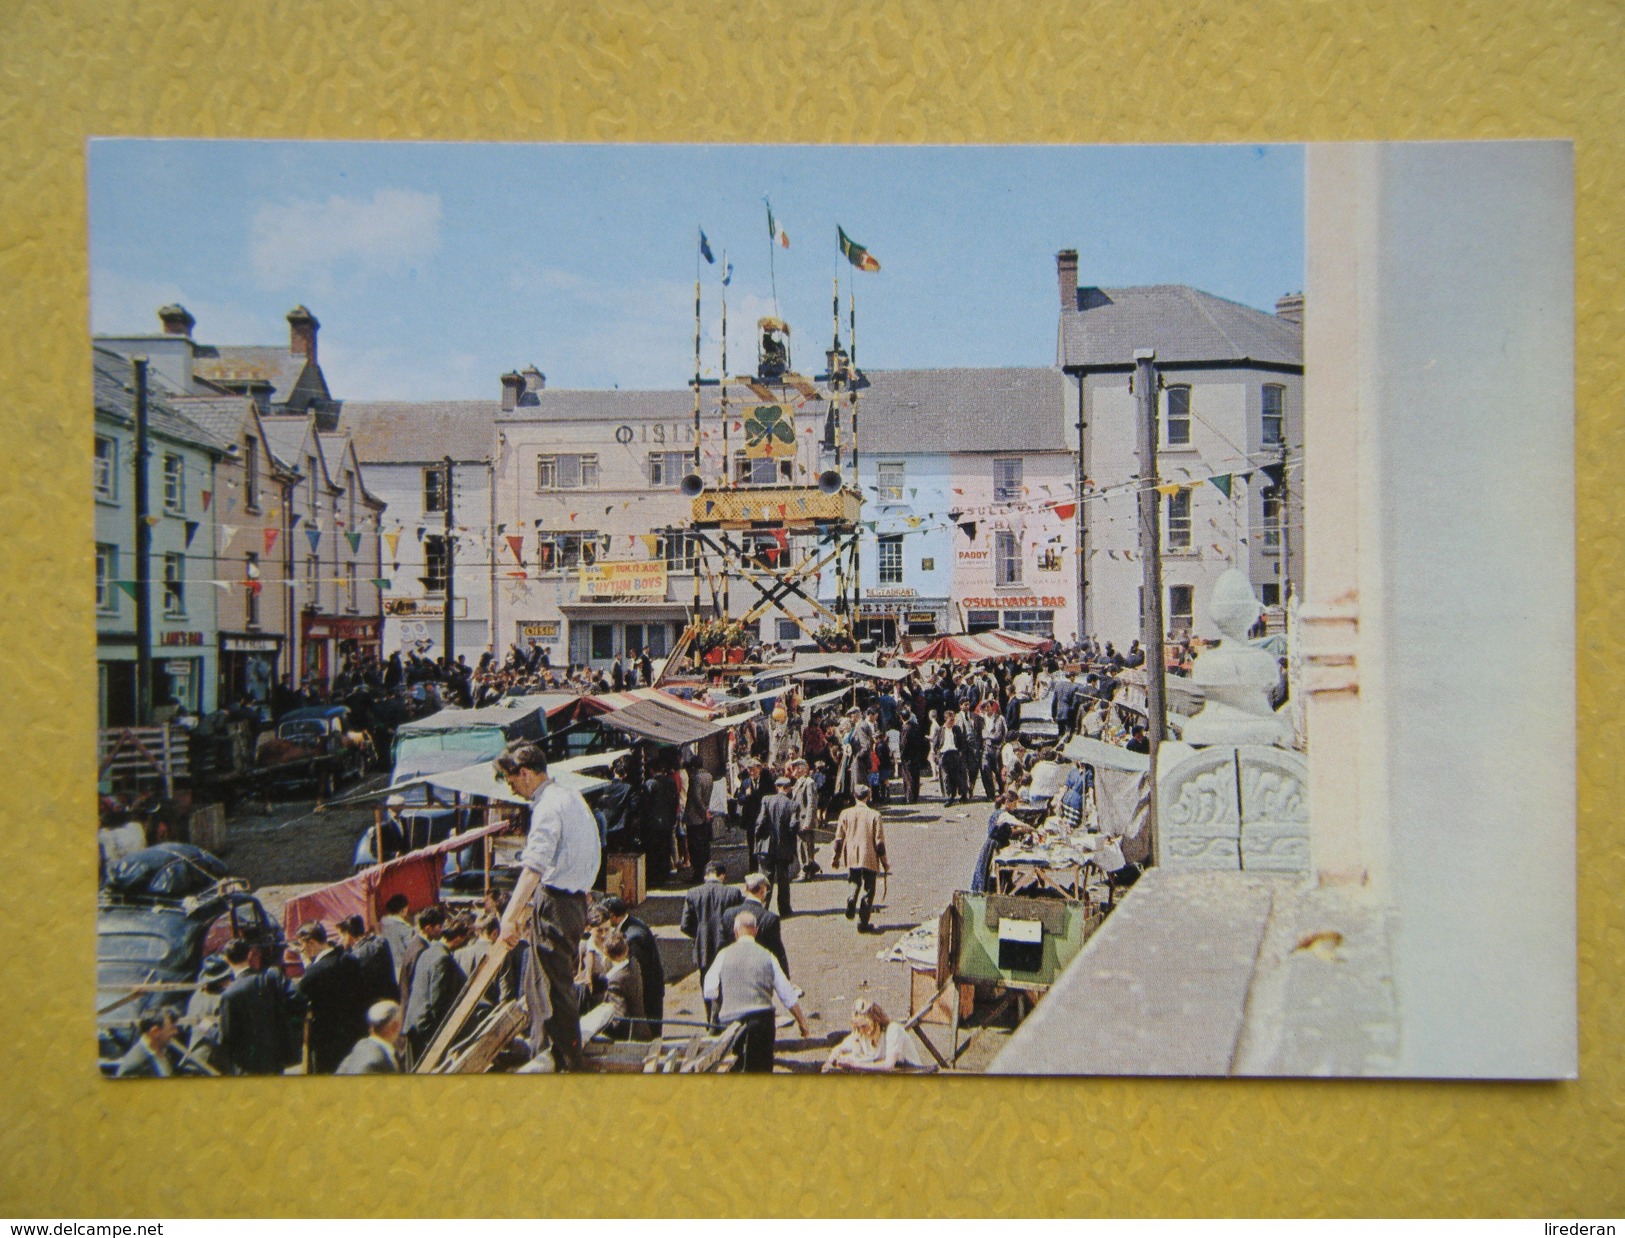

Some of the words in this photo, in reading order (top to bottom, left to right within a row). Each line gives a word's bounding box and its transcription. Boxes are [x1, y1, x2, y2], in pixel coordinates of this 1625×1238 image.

[615, 424, 698, 443] OISIN
[959, 551, 988, 559] PADDY
[588, 580, 631, 594] RHYTHM
[634, 577, 662, 590] BOYS
[962, 596, 1037, 608] O'SULLIVAN'S
[1041, 596, 1066, 607] BAR
[525, 626, 556, 635] OISIN
